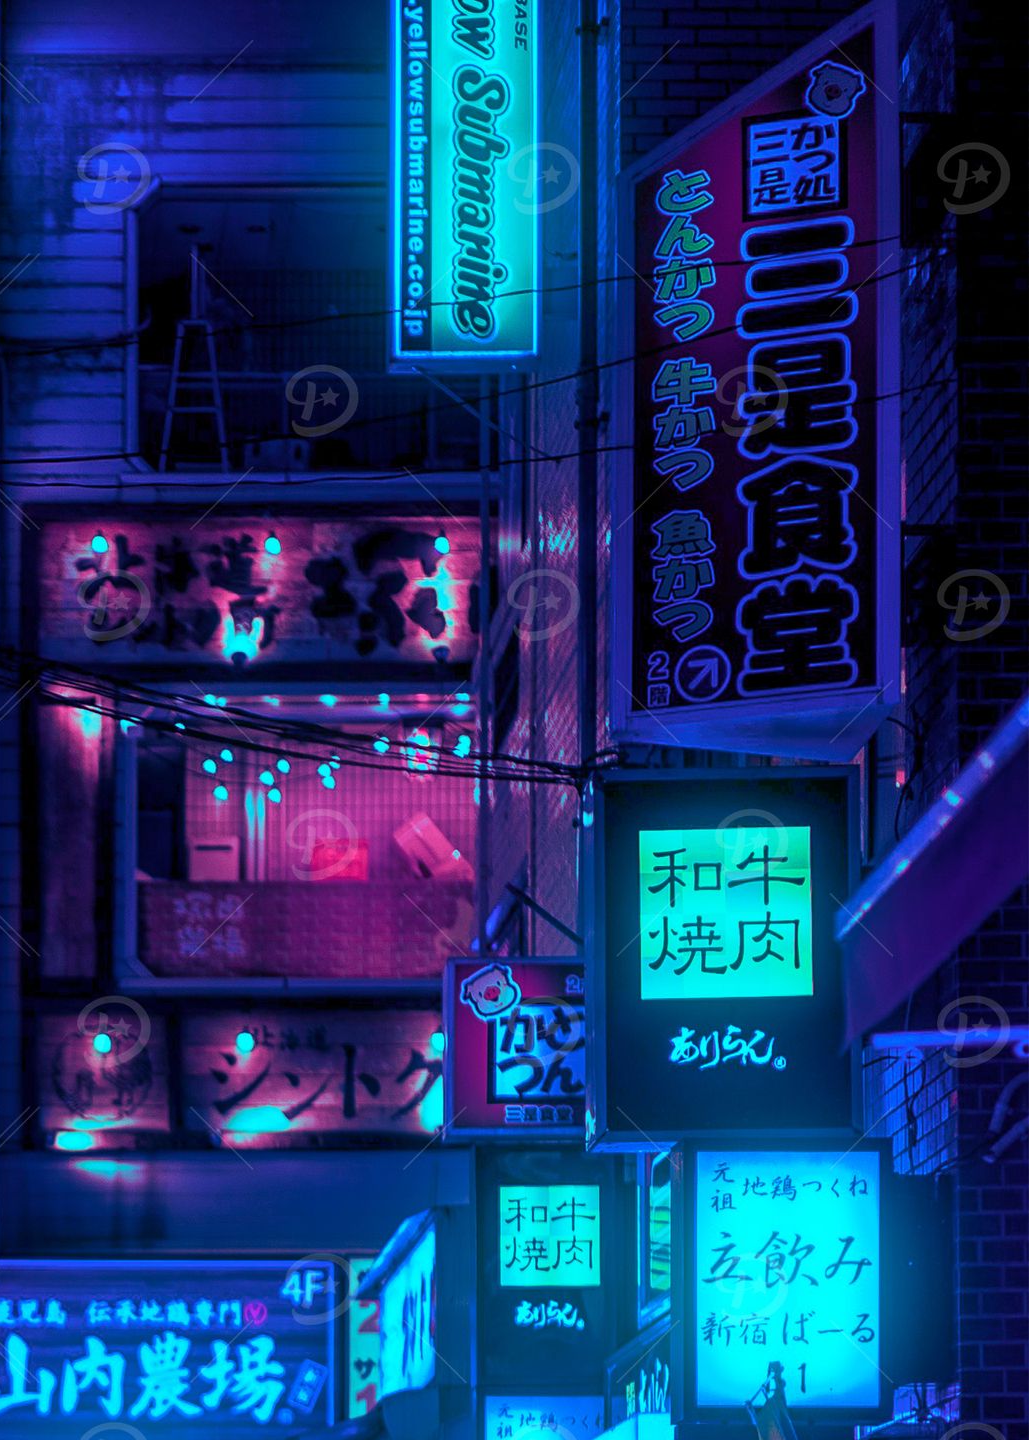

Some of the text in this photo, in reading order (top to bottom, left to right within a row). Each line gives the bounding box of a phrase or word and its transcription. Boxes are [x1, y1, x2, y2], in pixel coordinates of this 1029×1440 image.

[452, 64, 511, 342] Submarine
[654, 169, 716, 343] とんかつ
[652, 359, 716, 492] 牛かつ
[652, 509, 714, 642] 魚かつ
[648, 844, 806, 909] 和牛
[648, 914, 802, 976] 焼肉
[280, 1269, 325, 1306] 4F
[701, 1230, 874, 1292] 立飲み
